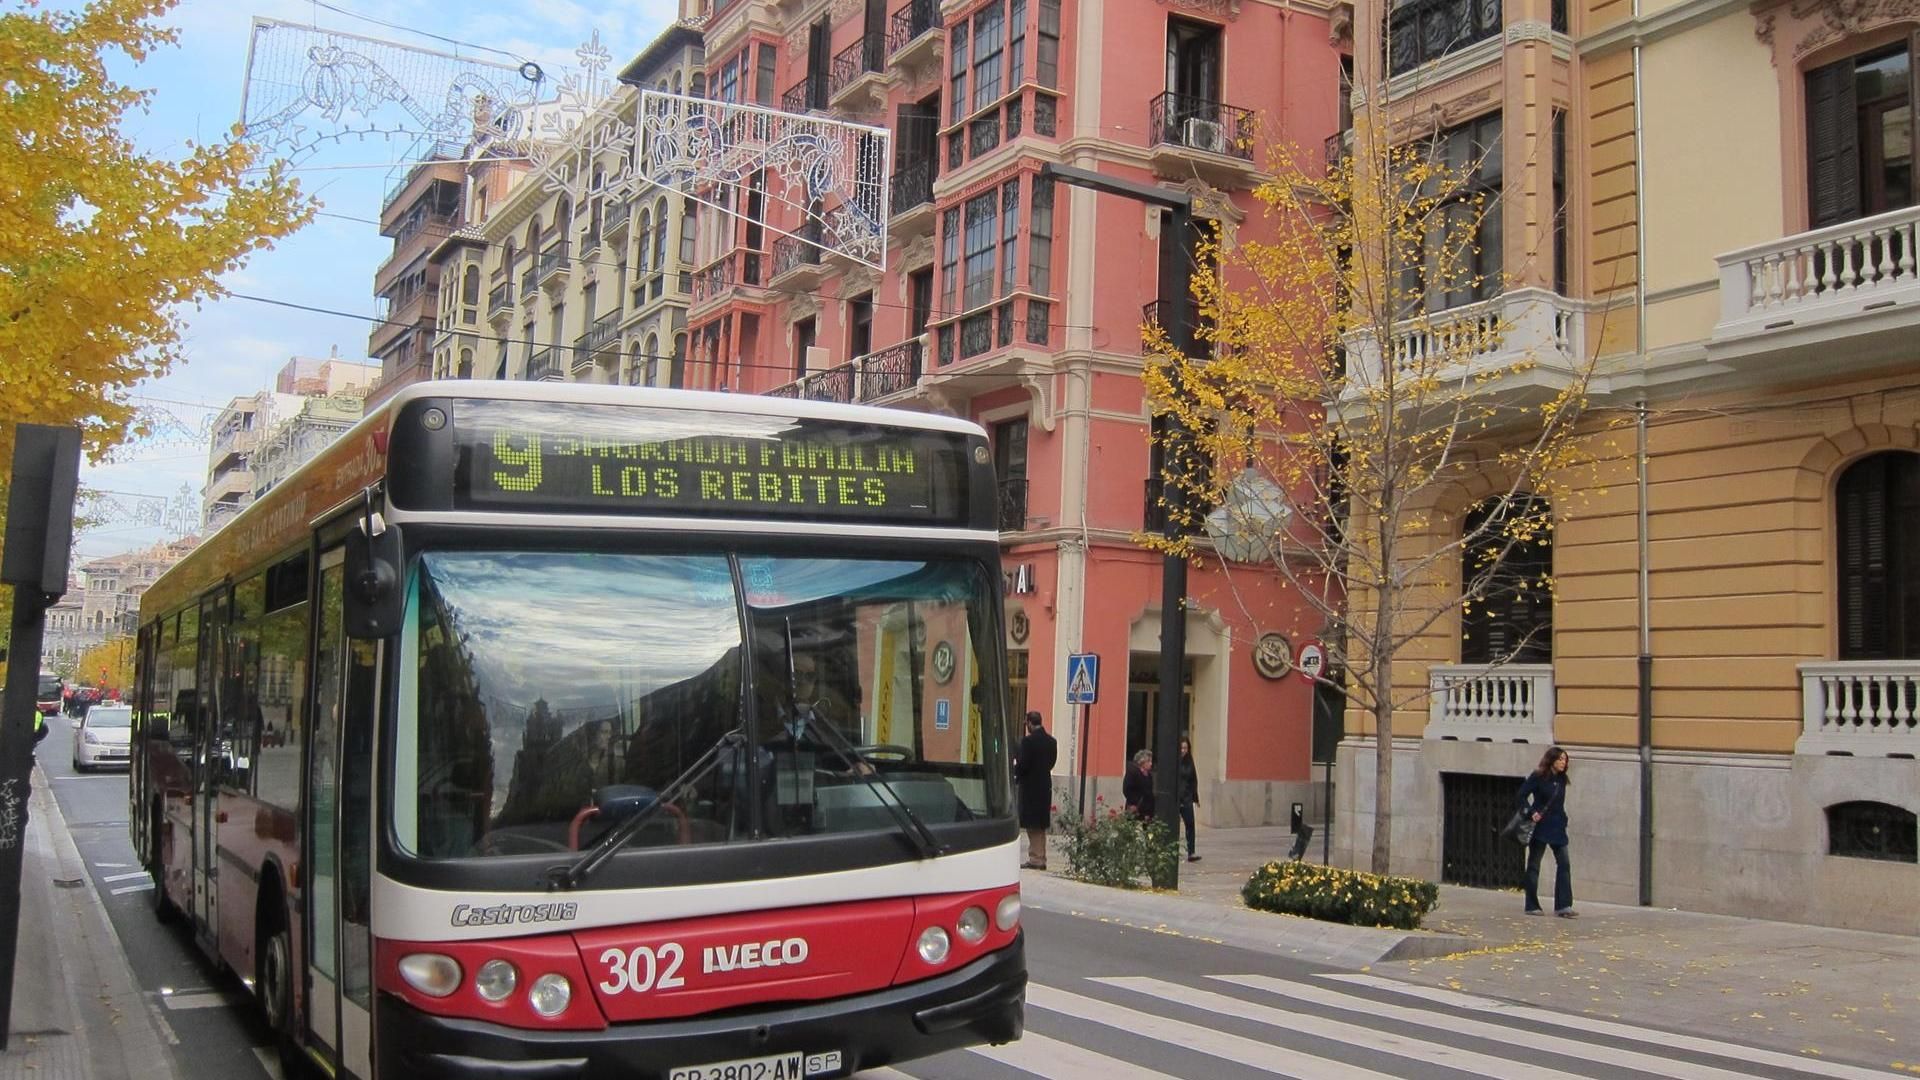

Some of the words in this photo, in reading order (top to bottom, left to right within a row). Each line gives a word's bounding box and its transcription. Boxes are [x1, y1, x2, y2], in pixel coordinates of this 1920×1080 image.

[493, 427, 542, 491] 9
[759, 438, 915, 474] FAMILIA
[592, 463, 679, 498] LOS
[700, 470, 887, 506] REBITES
[450, 901, 578, 927] Castrosua
[599, 942, 685, 995] 302
[703, 937, 809, 974] IVECO
[808, 1053, 840, 1073] SP
